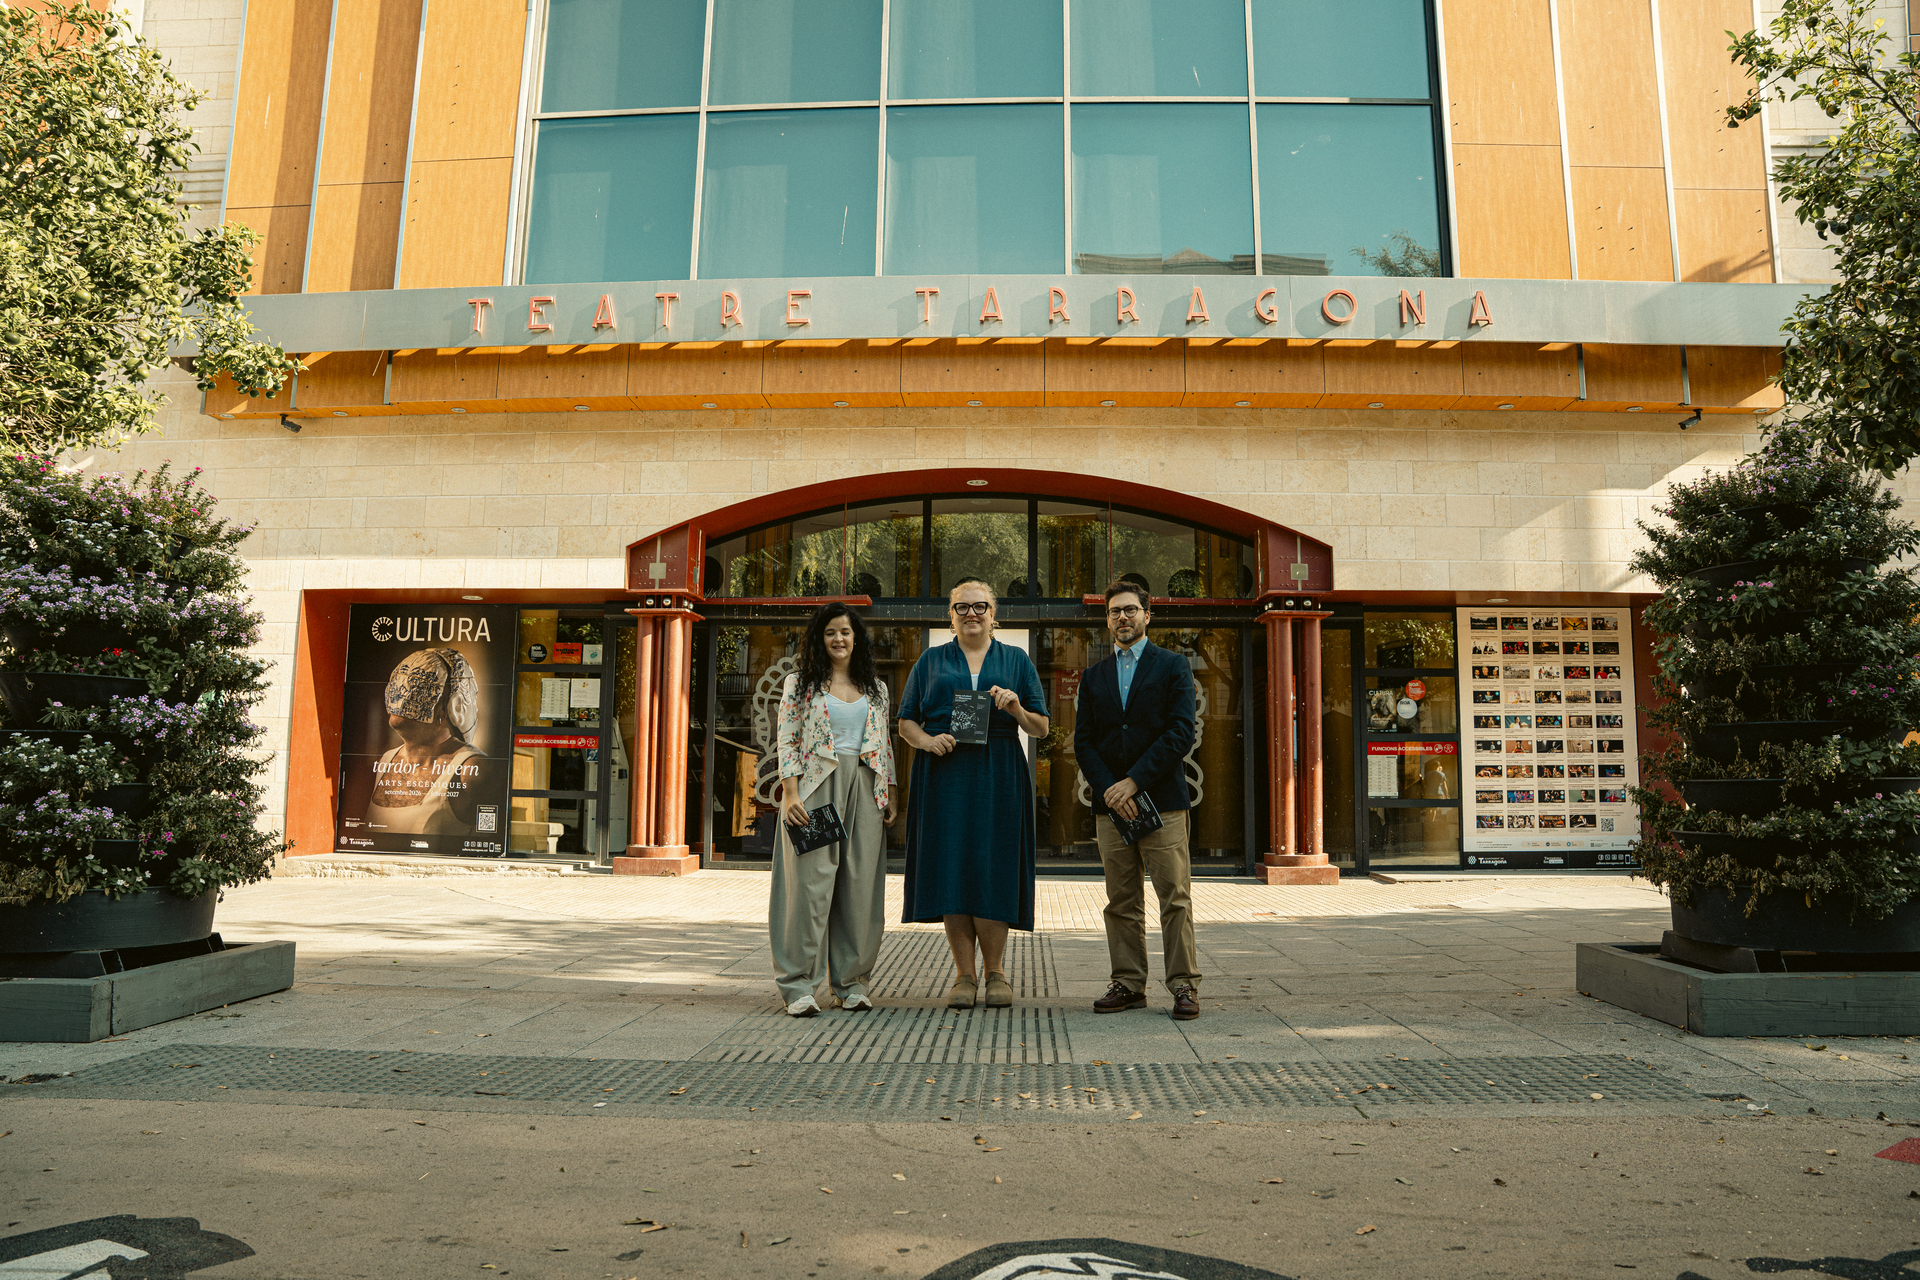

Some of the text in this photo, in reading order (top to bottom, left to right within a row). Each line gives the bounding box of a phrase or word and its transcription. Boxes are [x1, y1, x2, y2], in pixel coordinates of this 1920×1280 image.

[468, 287, 1494, 332] TEATRE TARRAGONA
[372, 616, 491, 642] CULTURA
[372, 758, 420, 774] tardor
[431, 760, 480, 776] hivern
[378, 779, 468, 790] ARTS ESCÈNIQUES
